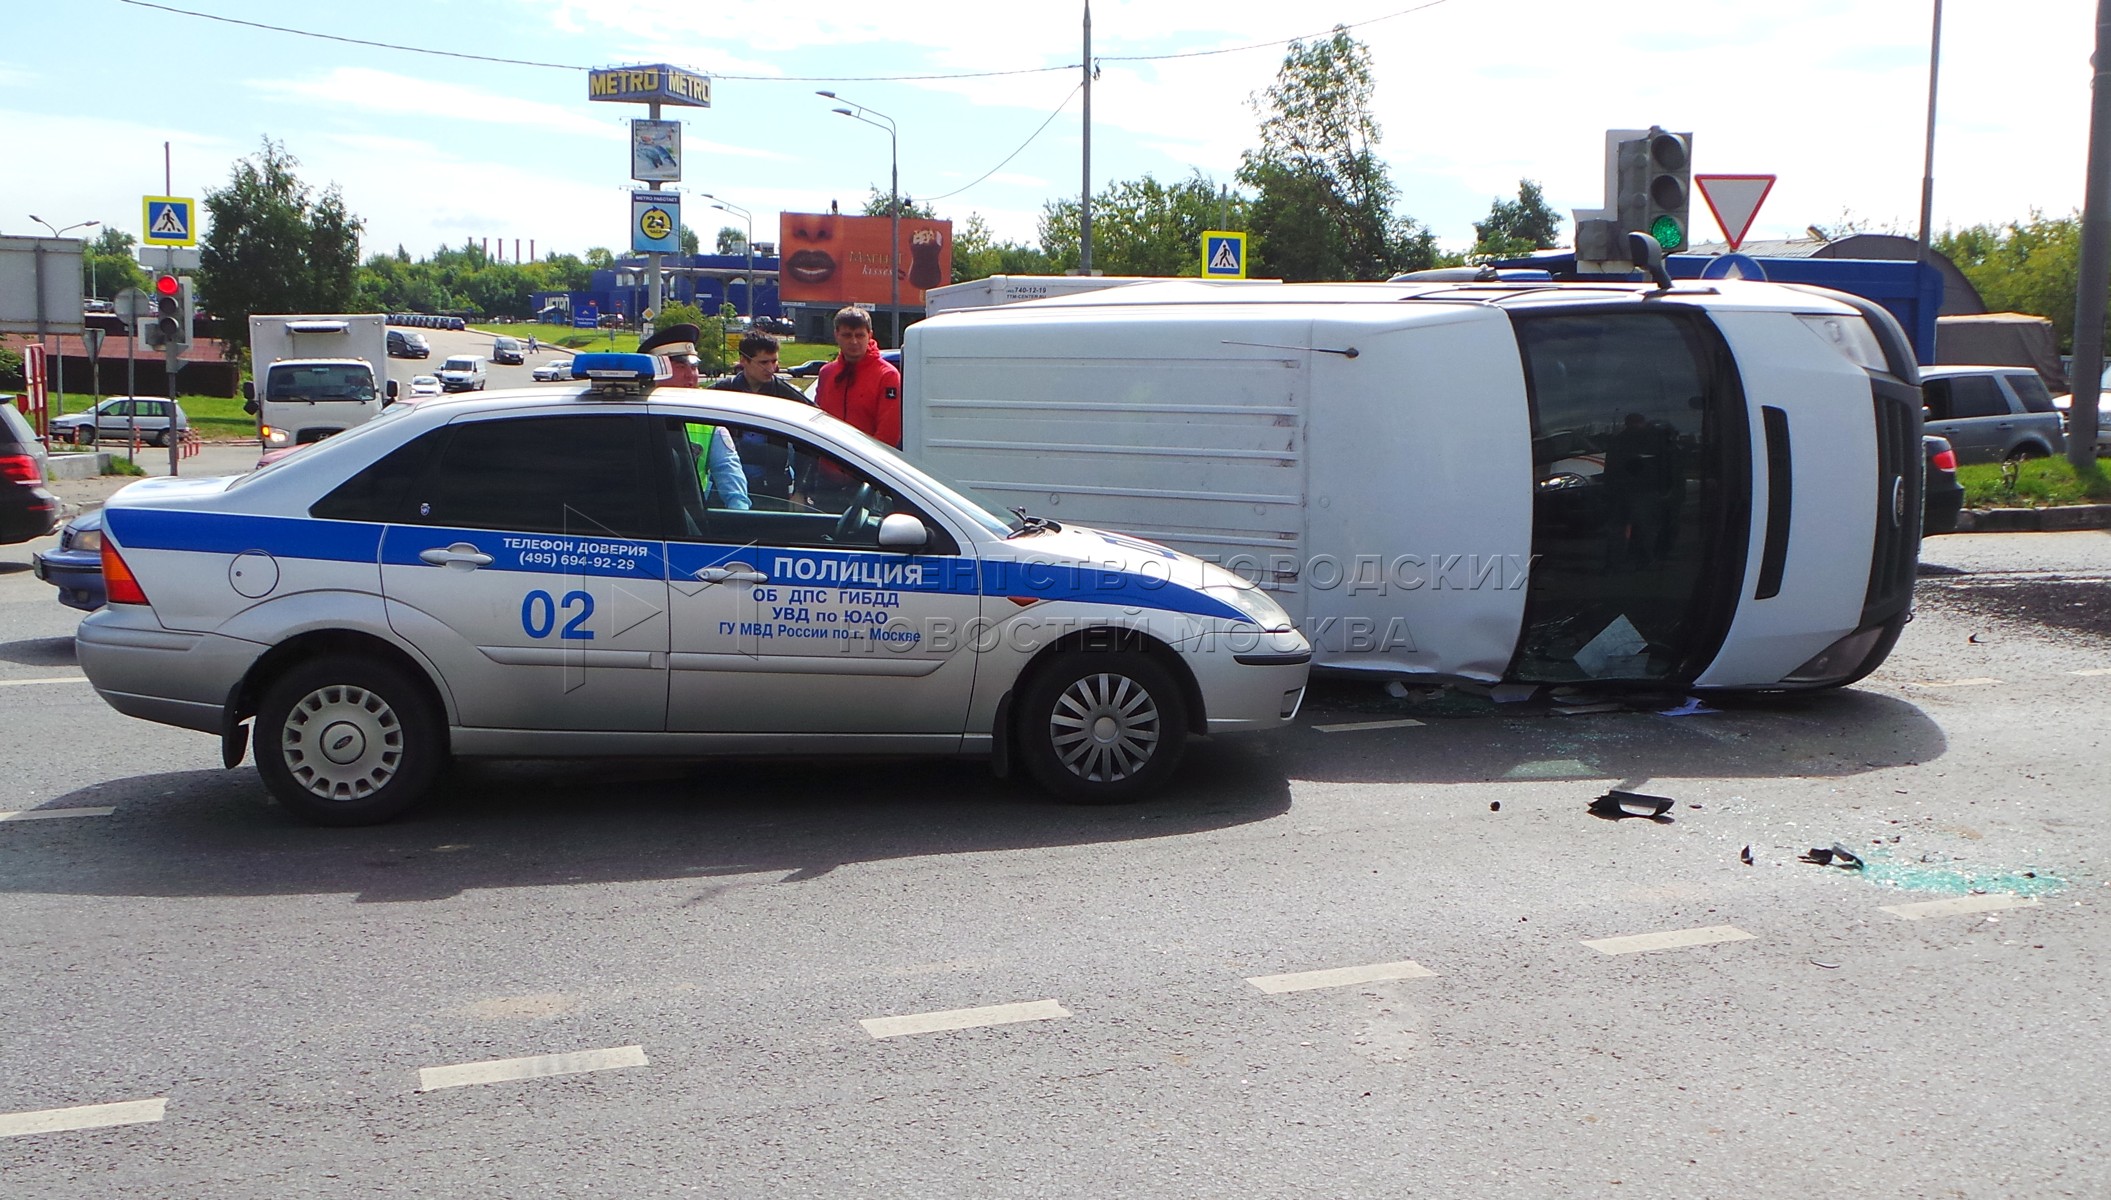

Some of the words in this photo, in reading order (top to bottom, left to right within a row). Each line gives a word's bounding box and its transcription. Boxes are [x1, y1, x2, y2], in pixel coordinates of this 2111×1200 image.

[590, 68, 659, 96] METRO
[668, 69, 711, 103] METRO
[647, 215, 665, 229] 24
[503, 538, 573, 552] ТЕЛЕФОН
[577, 544, 648, 557] ДОВЕРИЯ
[519, 551, 557, 567] (495)
[561, 554, 635, 571] 694-92-29
[774, 556, 923, 588] ПОЛИЦИЯ
[752, 588, 778, 602] ОБ
[789, 589, 827, 605] ДПС
[839, 590, 899, 608] ГИБДД
[521, 589, 595, 640] 02
[772, 606, 810, 623] УВД
[816, 612, 838, 623] по
[844, 609, 889, 625] ЮАО
[719, 621, 736, 635] ГУ
[740, 622, 773, 638] МВД
[778, 623, 828, 639] России
[832, 628, 849, 640] по
[854, 630, 865, 640] г.
[869, 627, 921, 643] Москве
